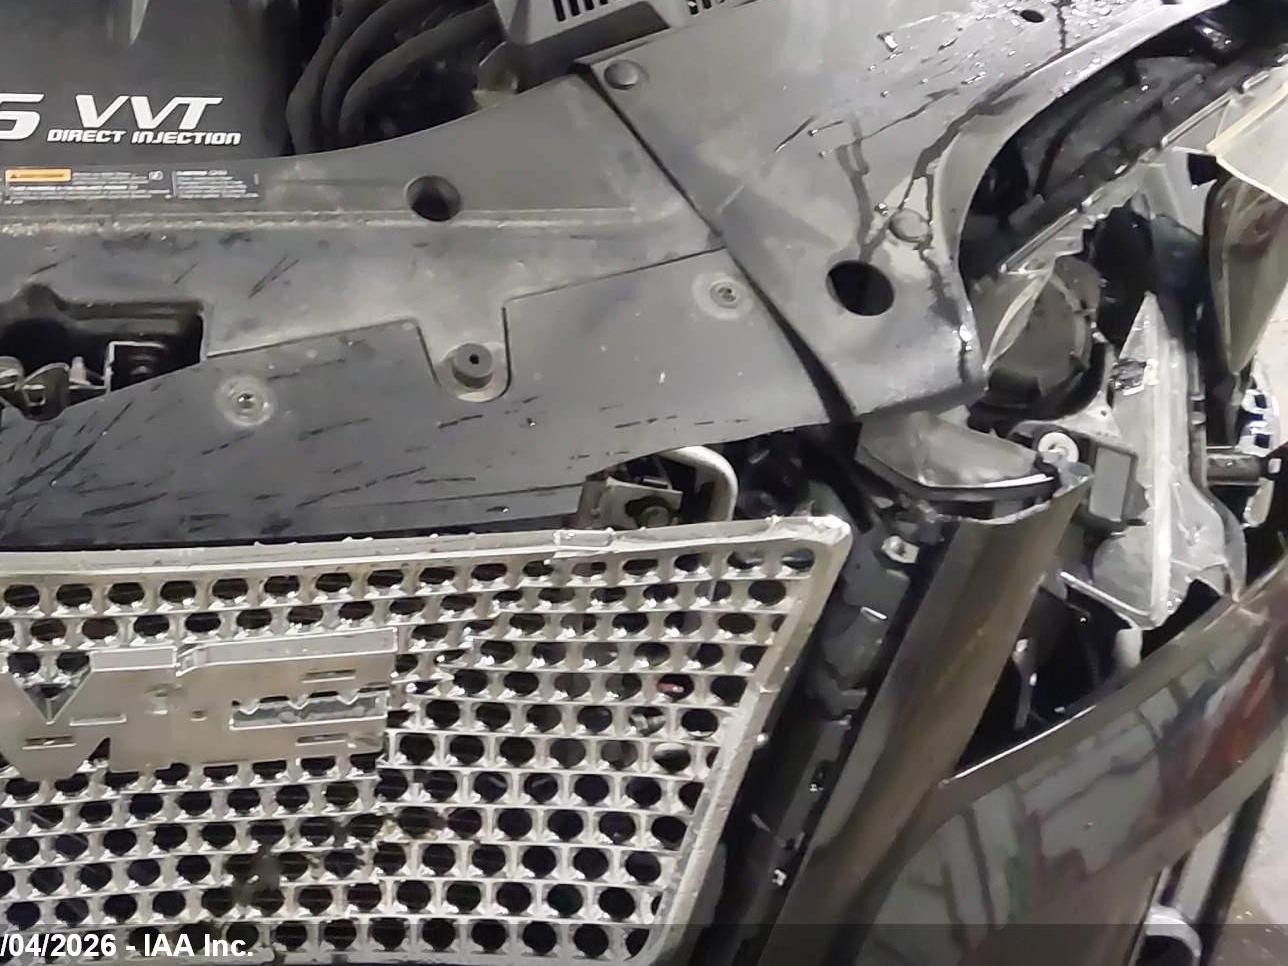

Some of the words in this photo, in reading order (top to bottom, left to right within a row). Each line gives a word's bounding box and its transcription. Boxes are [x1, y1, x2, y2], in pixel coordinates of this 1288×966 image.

[75, 94, 224, 130] VVT
[46, 128, 127, 143] DIRECT
[131, 130, 242, 145] INJECTION
